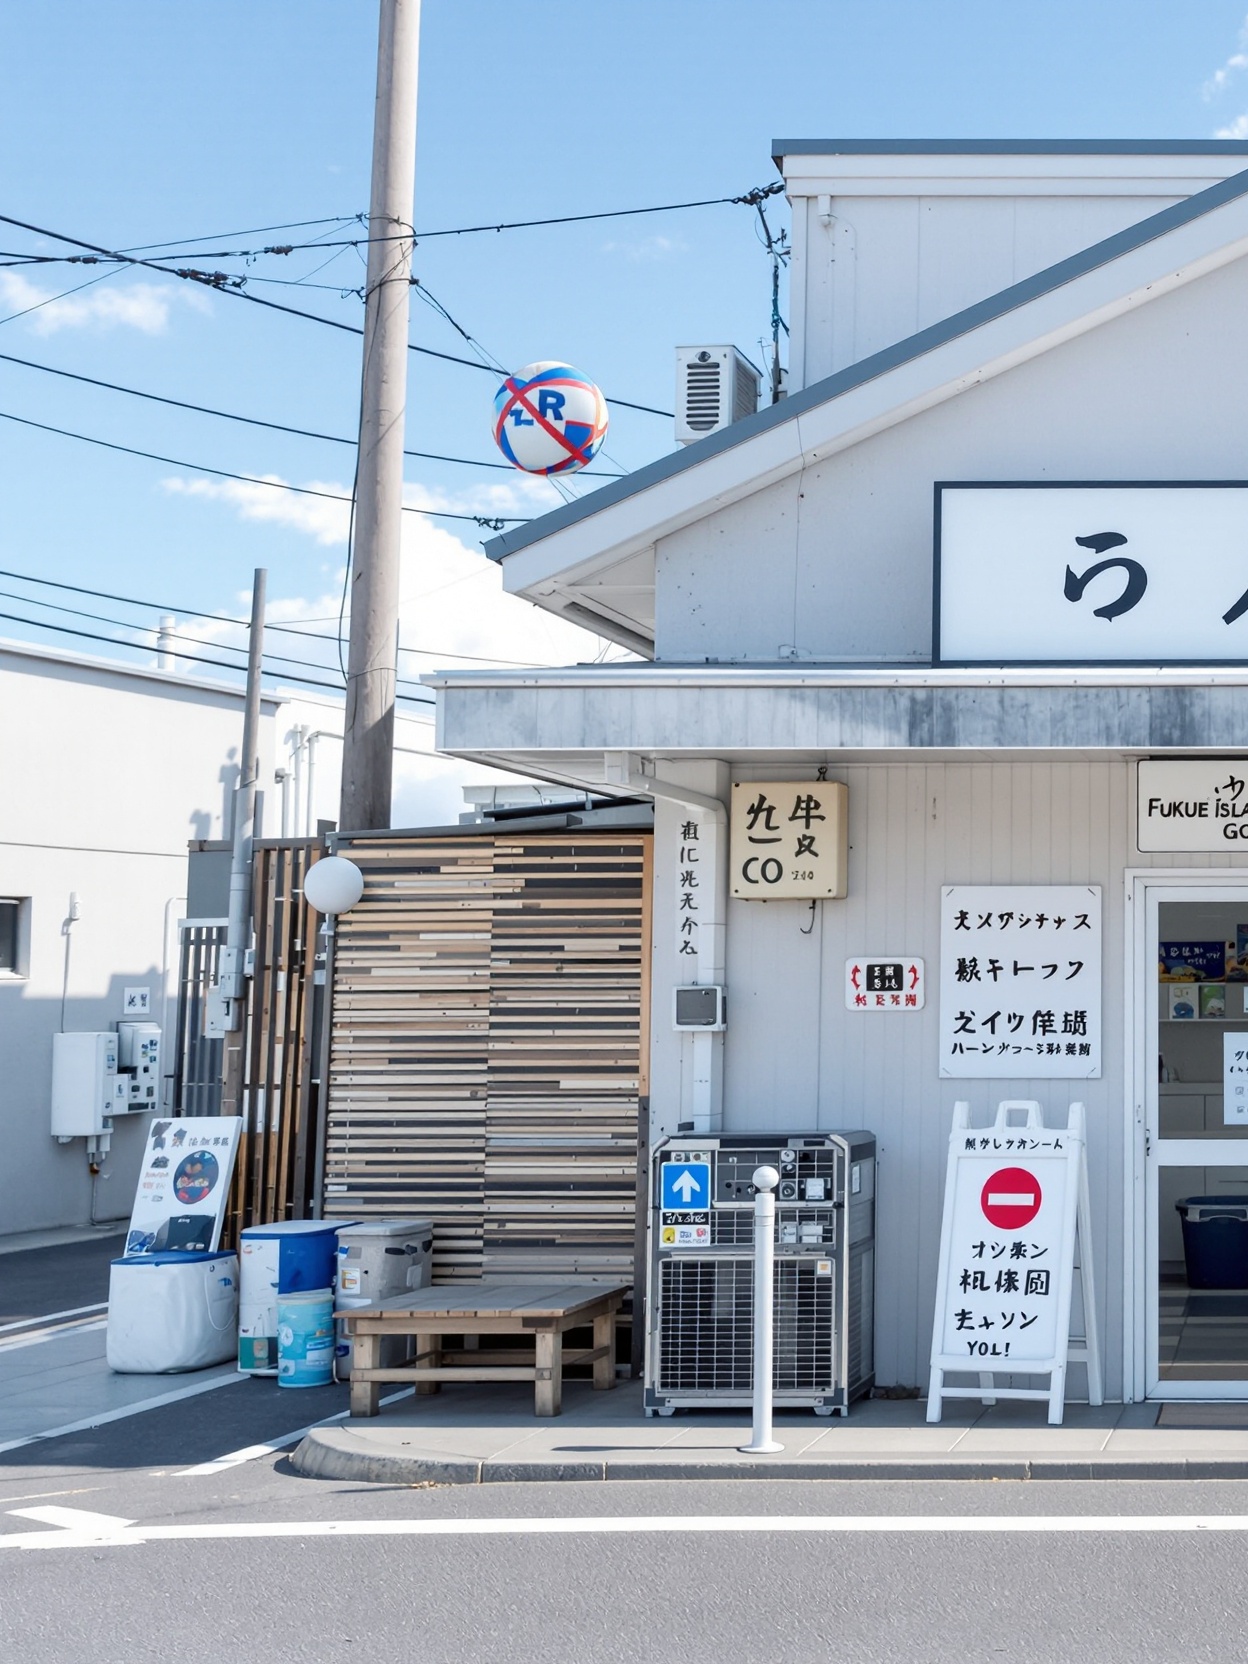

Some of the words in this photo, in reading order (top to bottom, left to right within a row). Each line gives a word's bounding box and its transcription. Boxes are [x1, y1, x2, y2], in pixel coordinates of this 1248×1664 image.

[538, 389, 566, 421] R
[1148, 798, 1209, 818] FUKUE
[742, 857, 783, 884] CO
